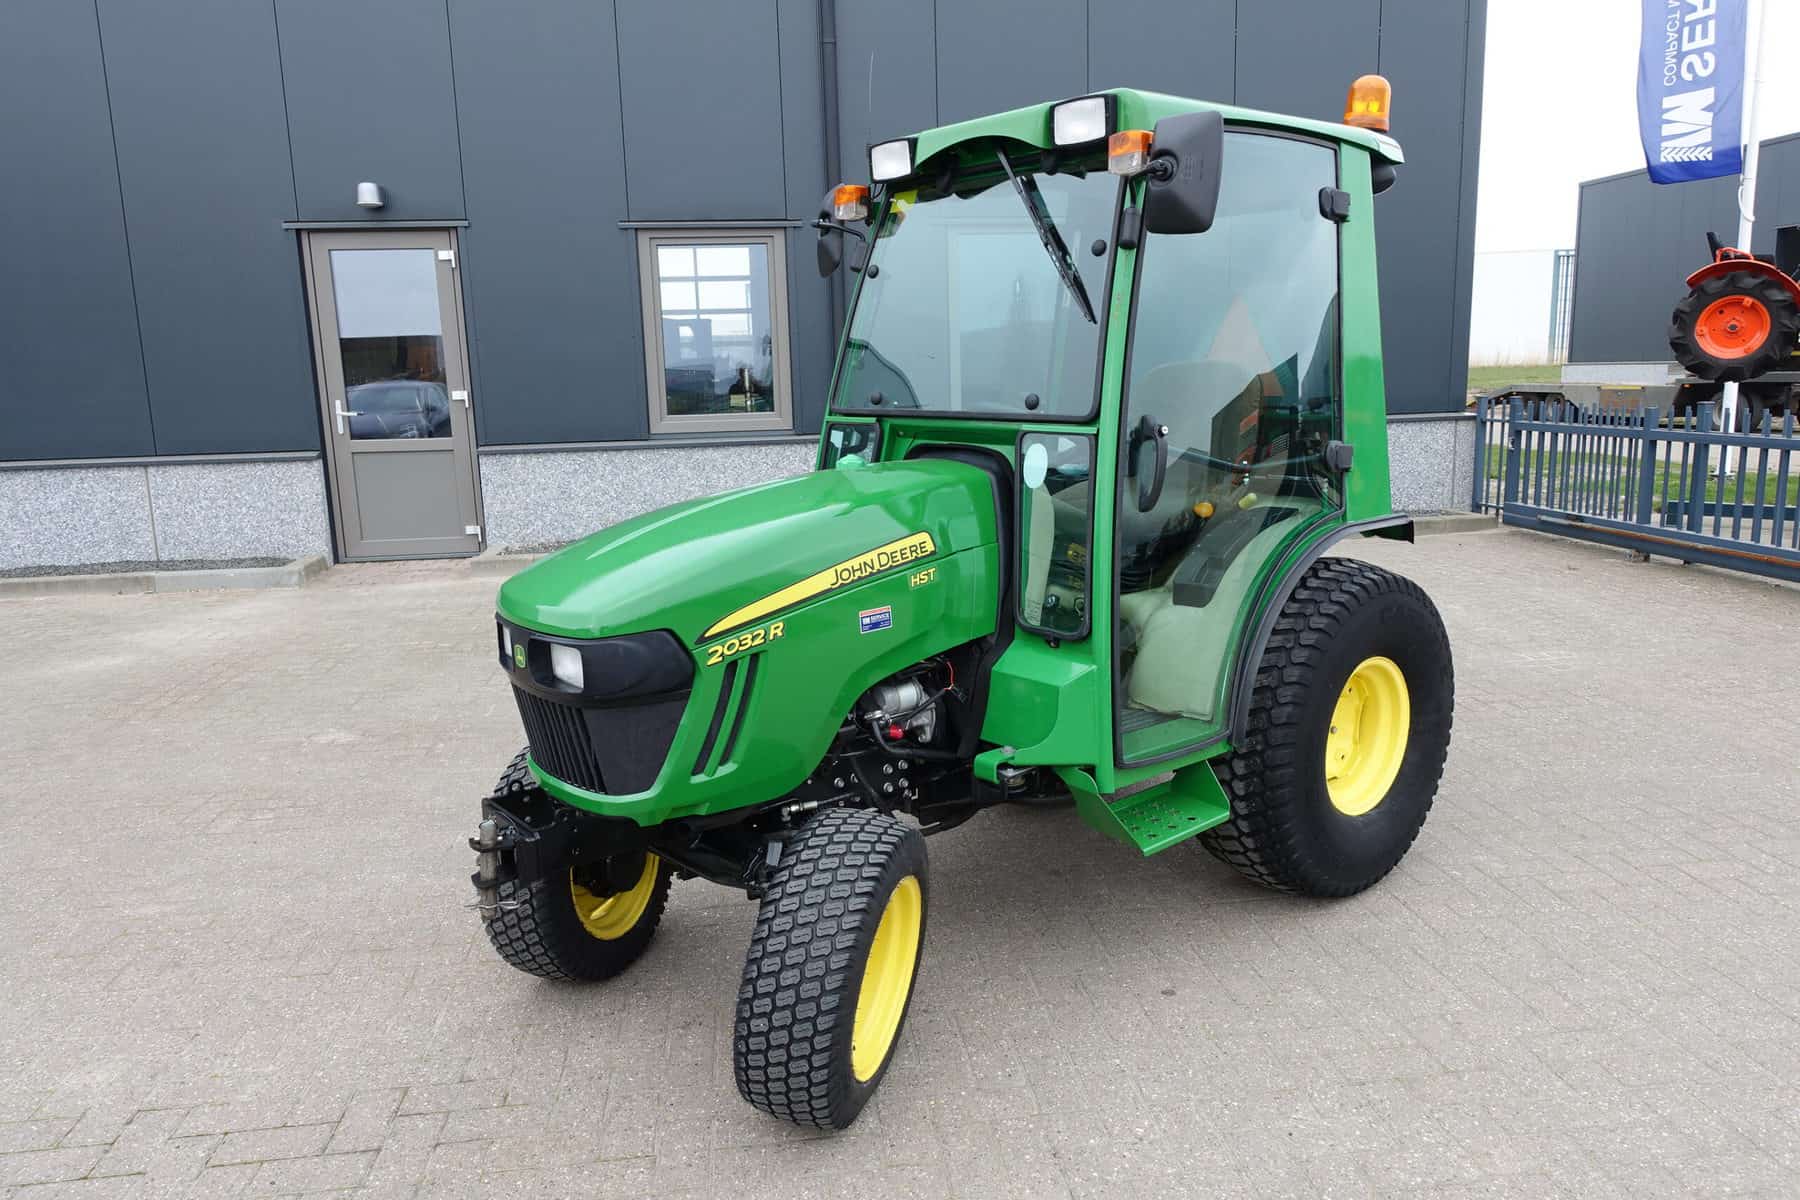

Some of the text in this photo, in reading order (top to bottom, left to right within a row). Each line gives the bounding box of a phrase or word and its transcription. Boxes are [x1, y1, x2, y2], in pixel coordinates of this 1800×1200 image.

[831, 541, 929, 587] JOHN DEERE
[911, 568, 936, 588] HST
[706, 622, 784, 666] 2032 R
